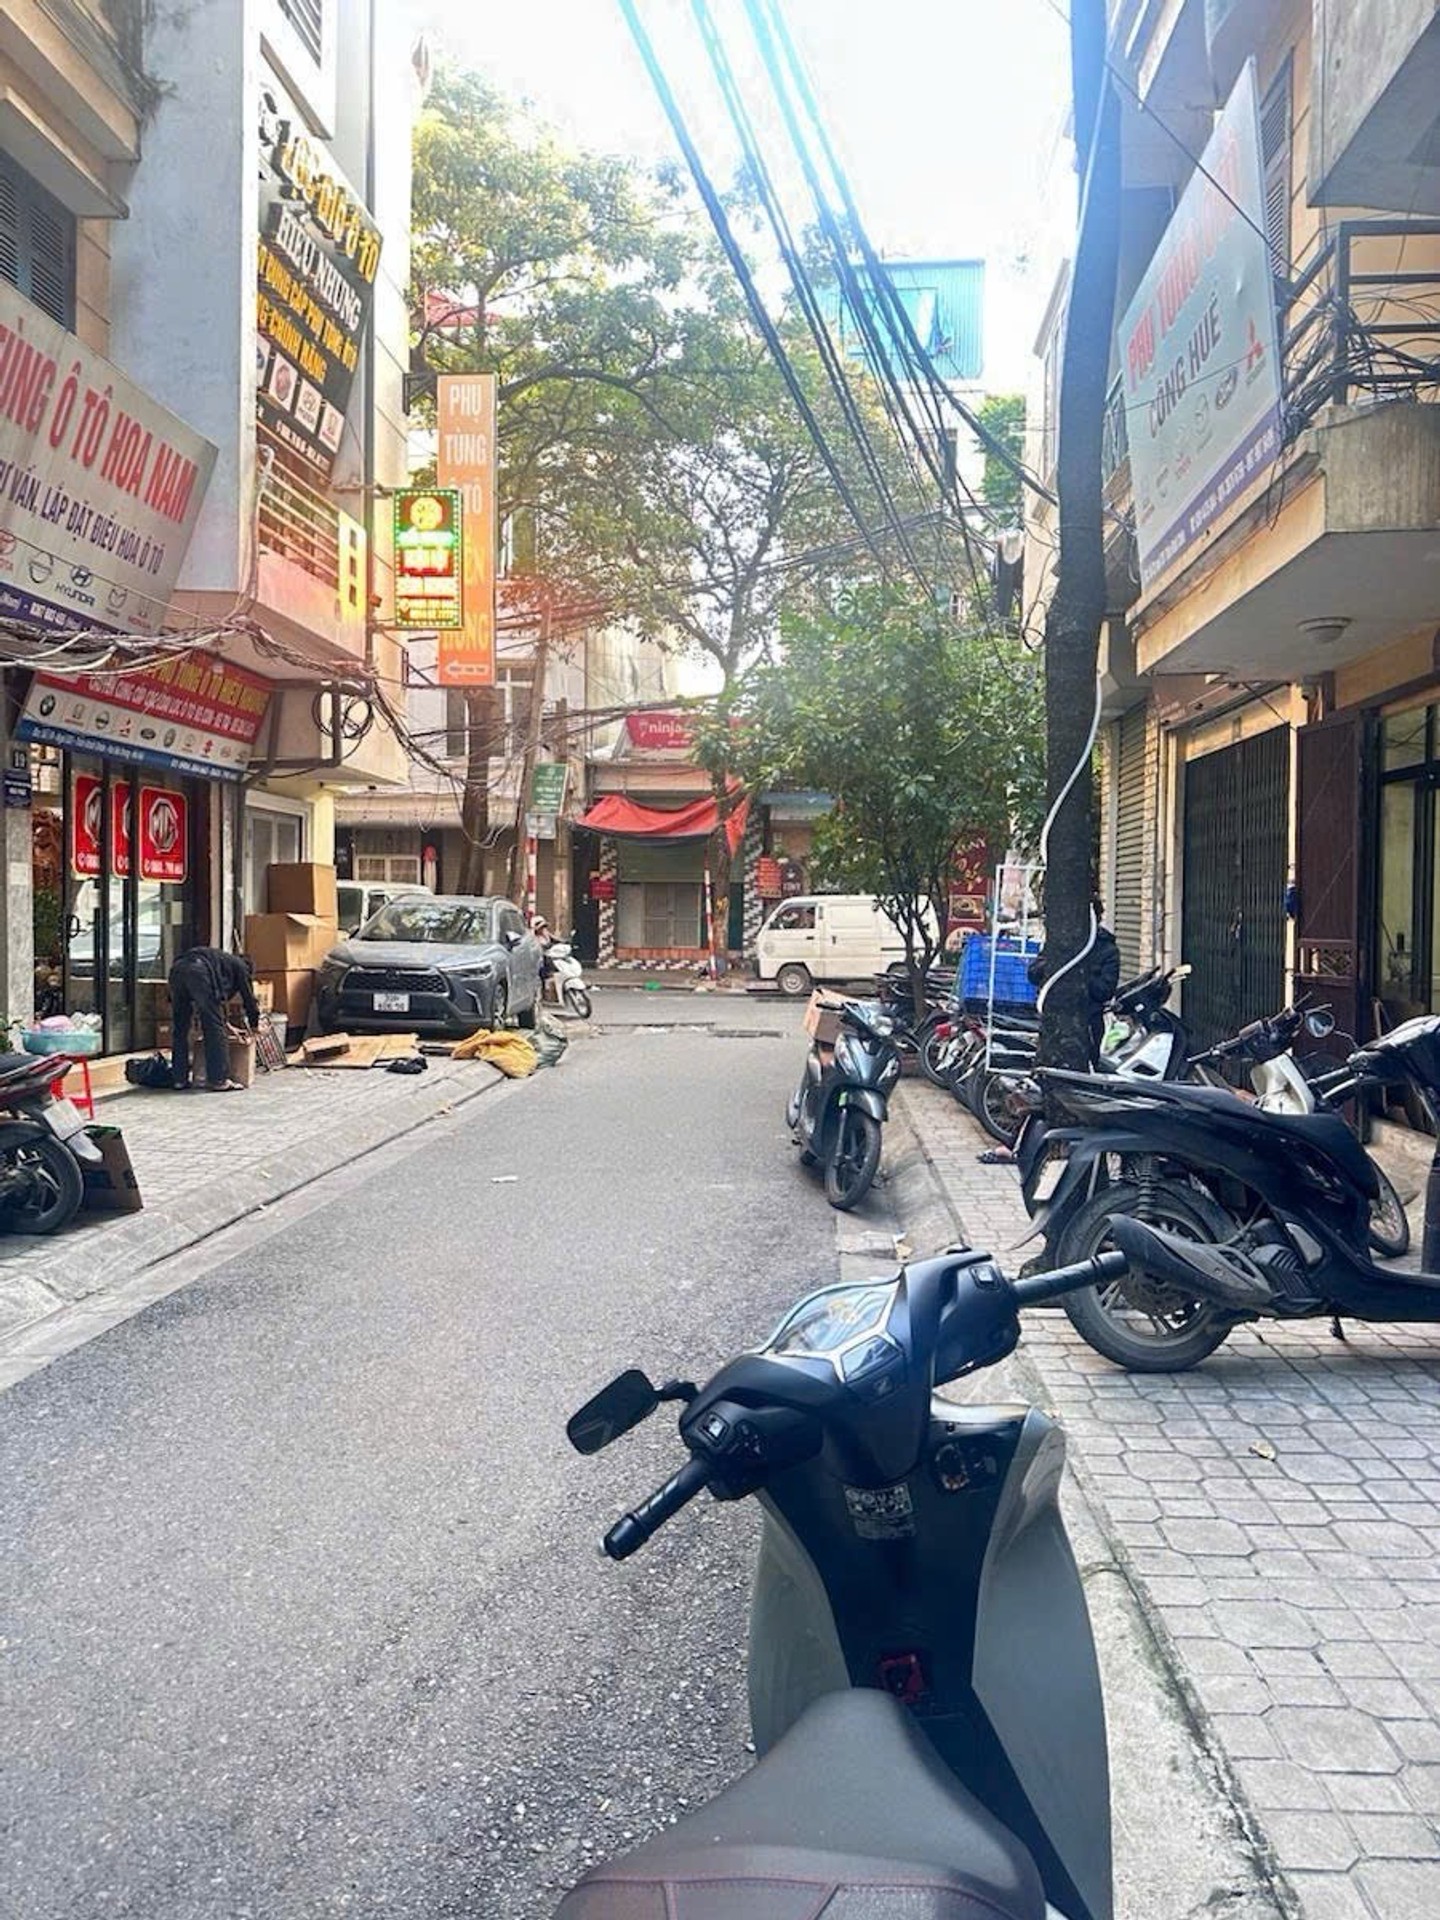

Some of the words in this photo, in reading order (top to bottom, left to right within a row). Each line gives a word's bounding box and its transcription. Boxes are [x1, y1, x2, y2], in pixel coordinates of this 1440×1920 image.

[449, 383, 482, 424] PHỤ
[49, 360, 82, 450] Ô
[71, 384, 113, 470] TÔ
[100, 411, 153, 498] HOA
[144, 442, 199, 525] NAM
[444, 427, 487, 466] TÙNG
[40, 481, 70, 525] LẮP
[66, 499, 94, 543] ĐẶT
